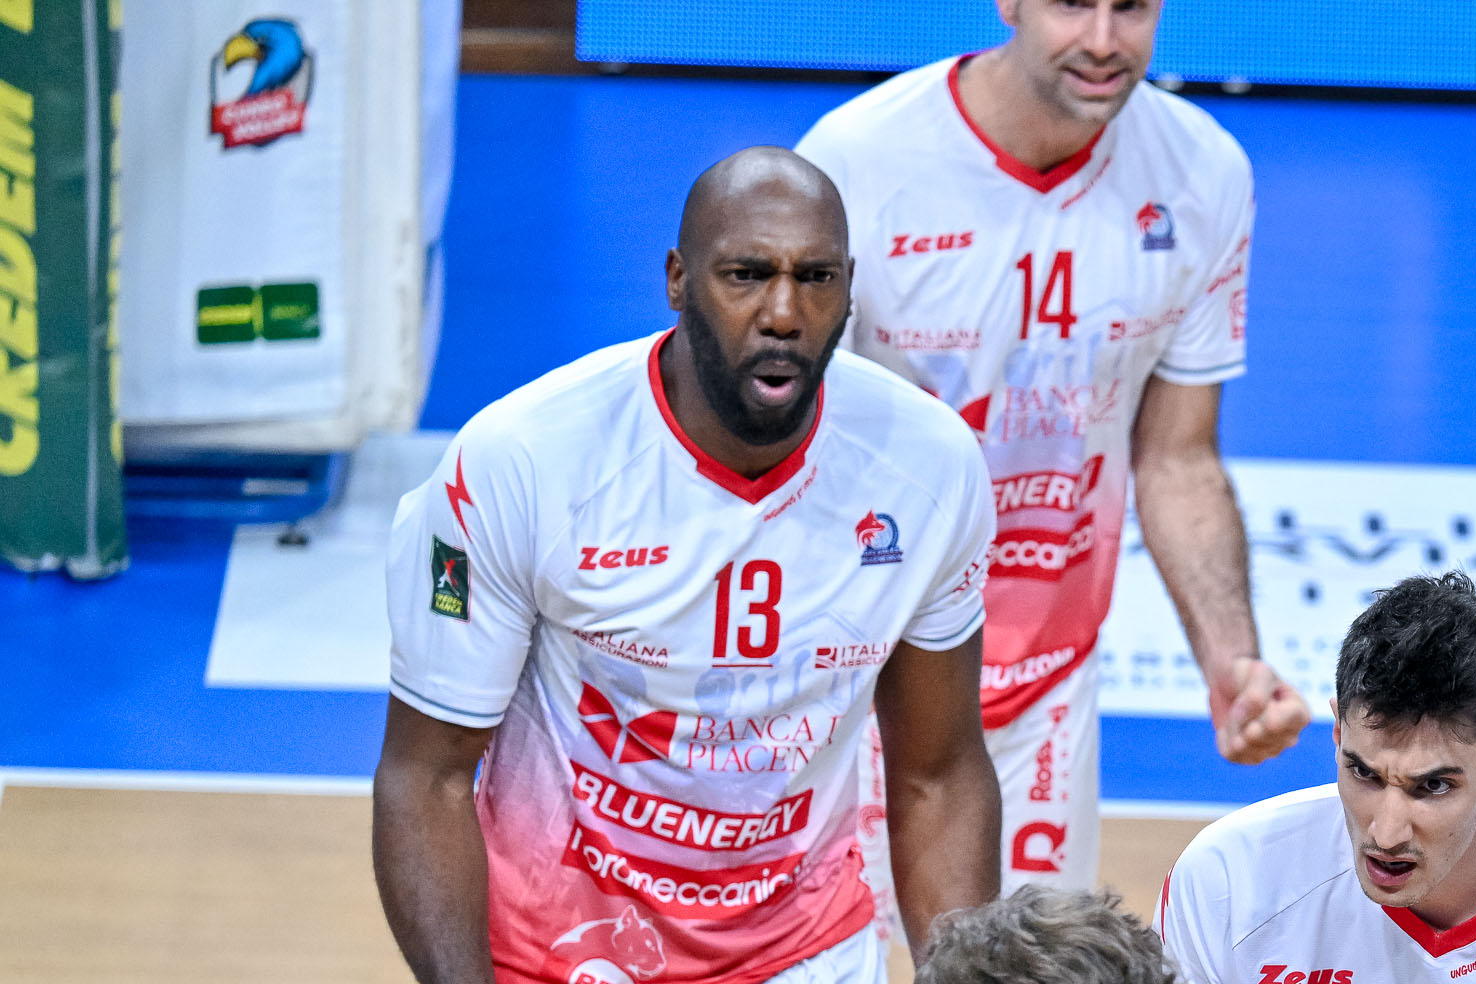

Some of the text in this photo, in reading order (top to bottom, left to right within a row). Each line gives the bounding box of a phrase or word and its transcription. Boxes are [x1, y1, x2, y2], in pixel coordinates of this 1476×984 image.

[889, 231, 974, 257] Zeus
[1015, 250, 1078, 340] 14
[578, 545, 670, 571] Zeus
[713, 559, 783, 659] 13
[591, 630, 669, 659] ALIANA
[841, 642, 888, 658] ITALI
[692, 712, 814, 743] BANCA
[686, 742, 818, 774] PIACEN
[571, 827, 800, 908] ordmeccanic
